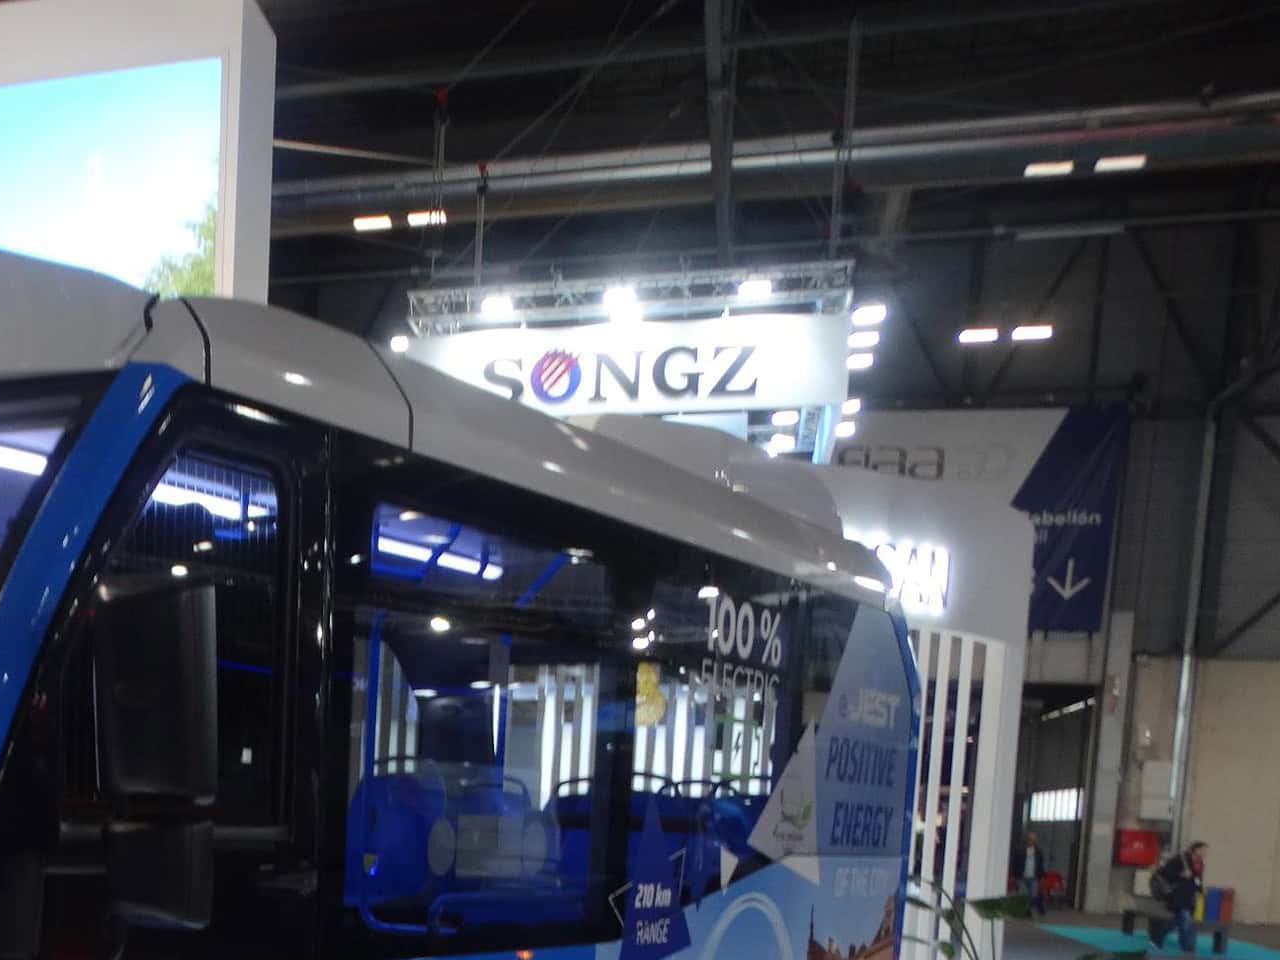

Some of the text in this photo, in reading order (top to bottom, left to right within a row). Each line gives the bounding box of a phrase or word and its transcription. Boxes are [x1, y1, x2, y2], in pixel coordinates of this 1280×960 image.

[483, 345, 759, 404] SONGZ
[706, 596, 756, 660] 100
[825, 735, 896, 788] POSITIVE
[830, 801, 893, 848] ENERGY
[635, 882, 672, 909] 210 km
[636, 918, 670, 945] RANGE
